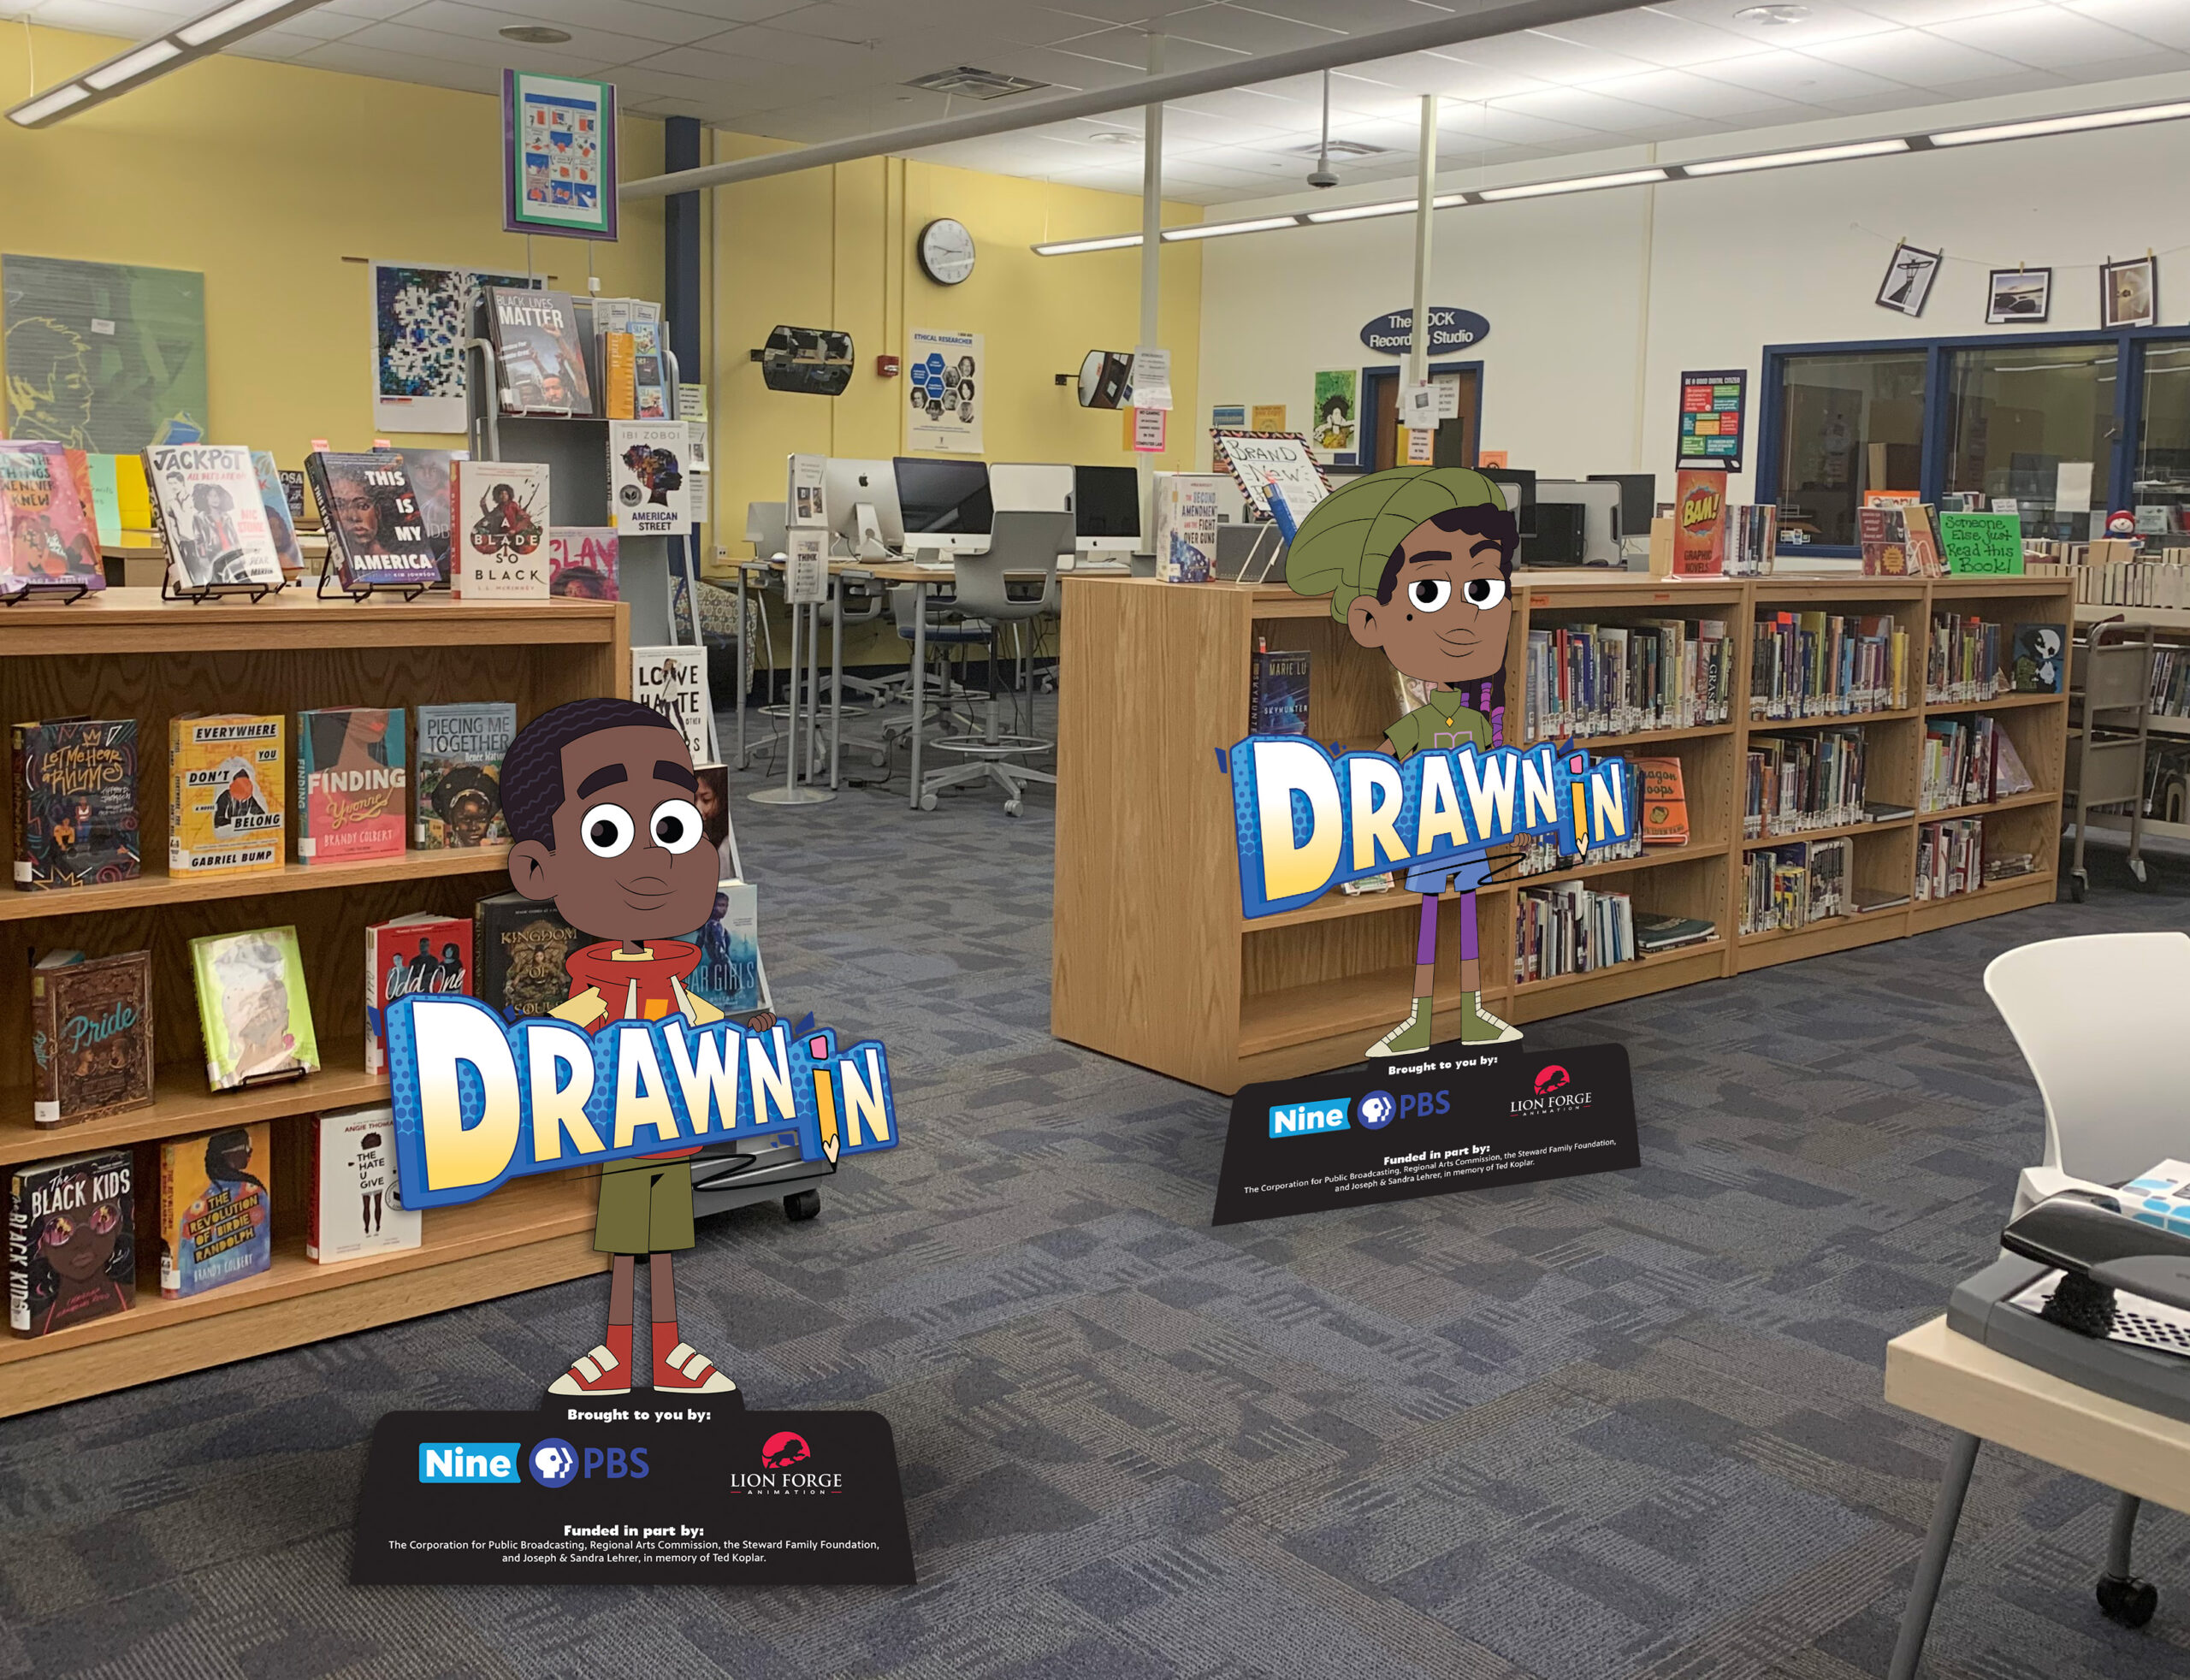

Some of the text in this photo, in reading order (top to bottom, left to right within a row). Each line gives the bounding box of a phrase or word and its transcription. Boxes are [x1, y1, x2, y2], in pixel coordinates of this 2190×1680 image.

[496, 295, 553, 309] BLACK LIVES
[499, 306, 564, 328] MATTER
[1388, 311, 1455, 328] The OCK
[938, 335, 973, 345] RESEARCHER
[1432, 329, 1474, 345] Studio
[622, 431, 680, 440] IBI ZOBOI
[1226, 440, 1297, 461] BRAND
[153, 449, 246, 470] JACKPOT
[364, 470, 405, 486] THIS
[1193, 492, 1216, 503] SECOND
[396, 499, 413, 513] IS
[1683, 494, 1721, 528] BAM!
[500, 518, 511, 528] A
[631, 512, 678, 521] AMERICAN
[1945, 516, 2006, 529] Someone
[638, 521, 672, 531] STREET
[1199, 519, 1216, 530] FIGHT
[395, 526, 422, 541] MY
[474, 534, 539, 546] BLADE
[1184, 532, 1216, 544] OVER GUNS
[1951, 529, 2012, 545] Else just
[1684, 550, 1712, 560] GRAPHIC
[1946, 543, 2014, 557] Read this
[353, 554, 433, 570] AMERICA
[495, 553, 518, 563] SO
[1959, 558, 2011, 573] Book!
[1684, 563, 1709, 573] NOVELS
[475, 570, 545, 584] BLACK
[1269, 662, 1306, 676] MARIE LU
[1264, 705, 1308, 715] SKYHUNTER
[428, 717, 510, 735] PIECING ME
[685, 717, 701, 725] OTHER
[196, 725, 276, 739] EVERYWHERE
[428, 735, 510, 753] TOGETHER
[258, 749, 277, 760] YOU
[188, 771, 229, 784] DON'T
[308, 768, 406, 794] FINDING
[326, 793, 389, 829] Yvonne
[234, 815, 280, 829] BELONG
[1253, 741, 1558, 901] DRAWN
[323, 829, 394, 847] BRANDY COLBERT
[191, 850, 272, 867] GABRIEL BUMP
[500, 927, 577, 944] KINGDOM
[385, 963, 466, 1001] Odd One
[714, 961, 755, 991] GIRLS
[65, 1002, 139, 1055] Pride
[1388, 1062, 1436, 1075] Brought
[1456, 1059, 1477, 1069] you
[1481, 1056, 1498, 1067] by:
[411, 1000, 797, 1192] DRAWN
[1511, 1092, 1592, 1112] LION FORGE
[1275, 1090, 1451, 1133] Nine PBS
[1523, 1105, 1580, 1116] ANIMATION
[344, 1124, 366, 1133] ANGIE
[357, 1151, 376, 1162] THE
[1383, 1145, 1490, 1165] Funded in part by:
[359, 1158, 385, 1171] HATE
[1244, 1186, 1259, 1194] The
[1261, 1180, 1309, 1192] Corporation
[1324, 1174, 1348, 1184] Public
[1350, 1168, 1402, 1181] Broadcasting,
[1404, 1162, 1437, 1174] Regional
[1438, 1161, 1453, 1169] Arts
[1455, 1154, 1502, 1167] Commission,
[1518, 1146, 1548, 1158] Steward
[1549, 1144, 1573, 1155] Family
[1574, 1139, 1617, 1151] Foundation,
[360, 1171, 367, 1180] U
[1351, 1180, 1378, 1191] Joseph
[1388, 1175, 1415, 1186] Sandra
[1417, 1171, 1442, 1182] Lehrer,
[1444, 1169, 1452, 1178] in
[1453, 1166, 1484, 1177] memory
[1486, 1163, 1495, 1172] of
[1495, 1161, 1508, 1170] Ted
[1510, 1158, 1535, 1170] Koplar.
[49, 1174, 77, 1191] The
[360, 1176, 385, 1189] GIVE
[33, 1169, 131, 1218] BLACK KIDS
[208, 1192, 231, 1209] THE
[189, 1194, 258, 1234] REVOLUTION
[196, 1214, 251, 1246] OF BIRDIE
[195, 1227, 255, 1263] RANDOLPH
[193, 1253, 253, 1283] BRANDY COLBERT
[567, 1409, 711, 1423] Brought to you by:
[426, 1446, 649, 1479] Nine PBS
[731, 1473, 843, 1488] LION FORGE
[564, 1524, 704, 1539] Funded in part by:
[388, 1540, 880, 1552] The Corporation for Public Broadcasting, Regional Arts Commission, the Steward Family Foundation,
[501, 1553, 767, 1565] and Joseph & Sandra Lehrer, in memory of Ted Koplar.
